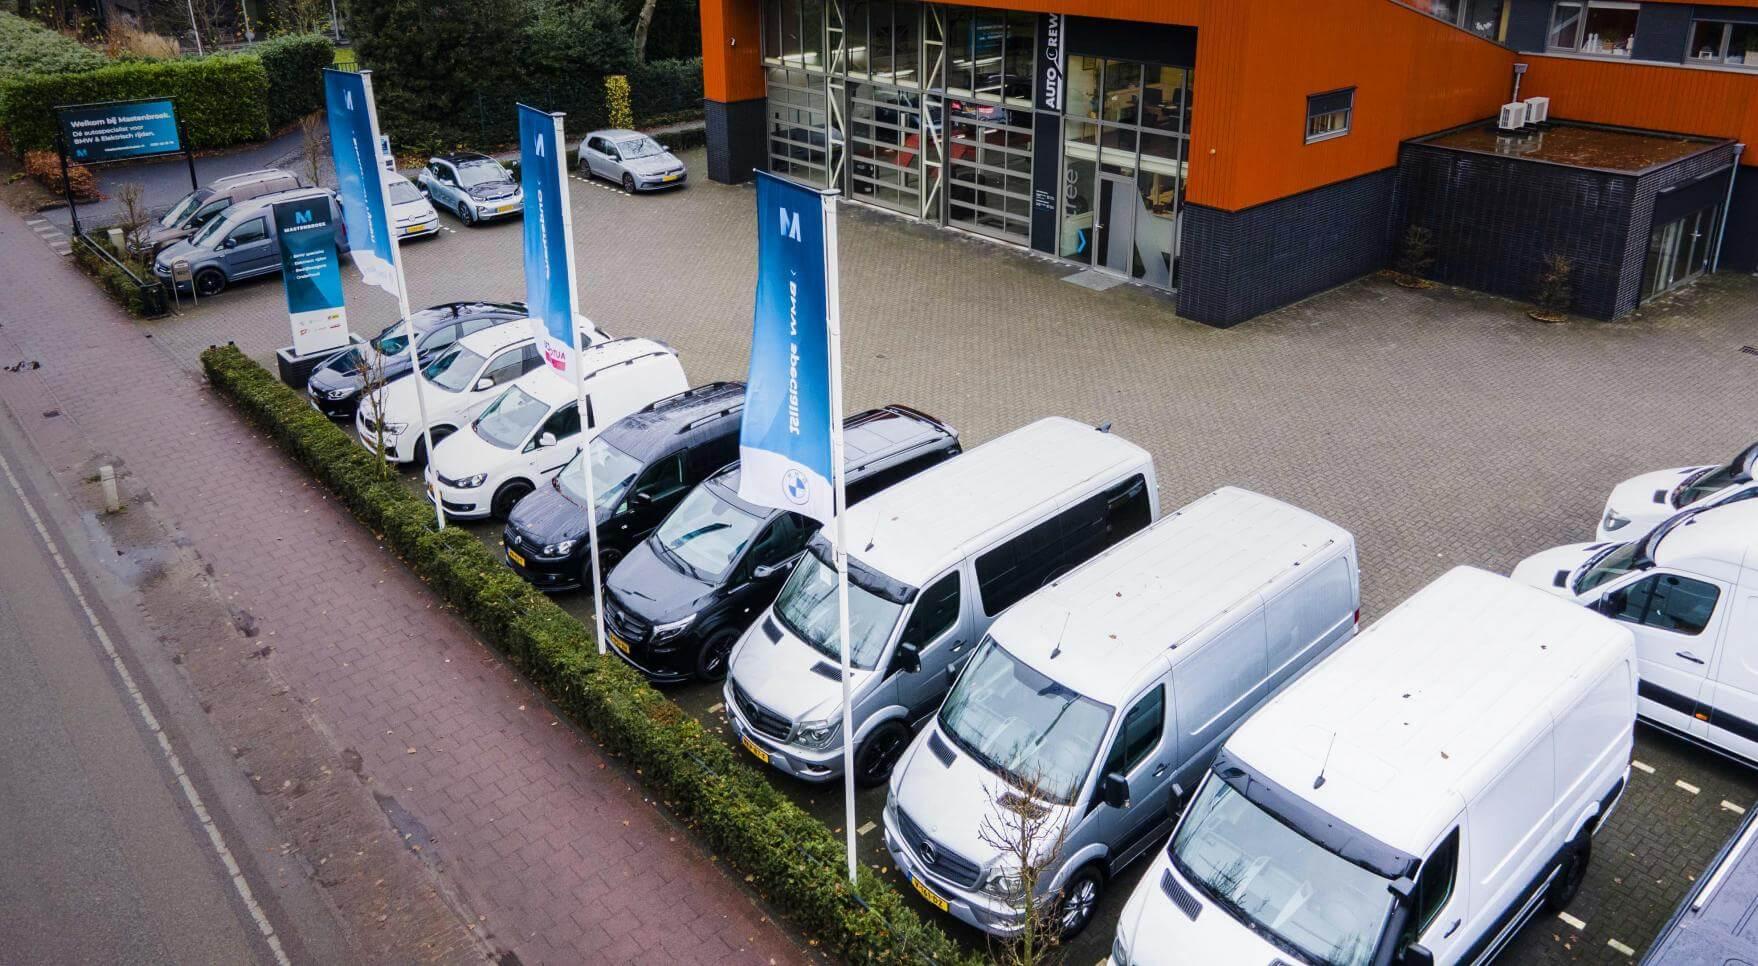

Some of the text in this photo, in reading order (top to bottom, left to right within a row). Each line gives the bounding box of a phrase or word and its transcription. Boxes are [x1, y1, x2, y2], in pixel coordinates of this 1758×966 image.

[1045, 13, 1059, 109] AUTO CREW
[70, 113, 170, 128] Welkom bij Mastenbroek.
[84, 126, 128, 136] autospecialist
[74, 137, 93, 145] BMW
[101, 132, 133, 142] Elektrisch
[284, 222, 326, 233] MASTENBROEK
